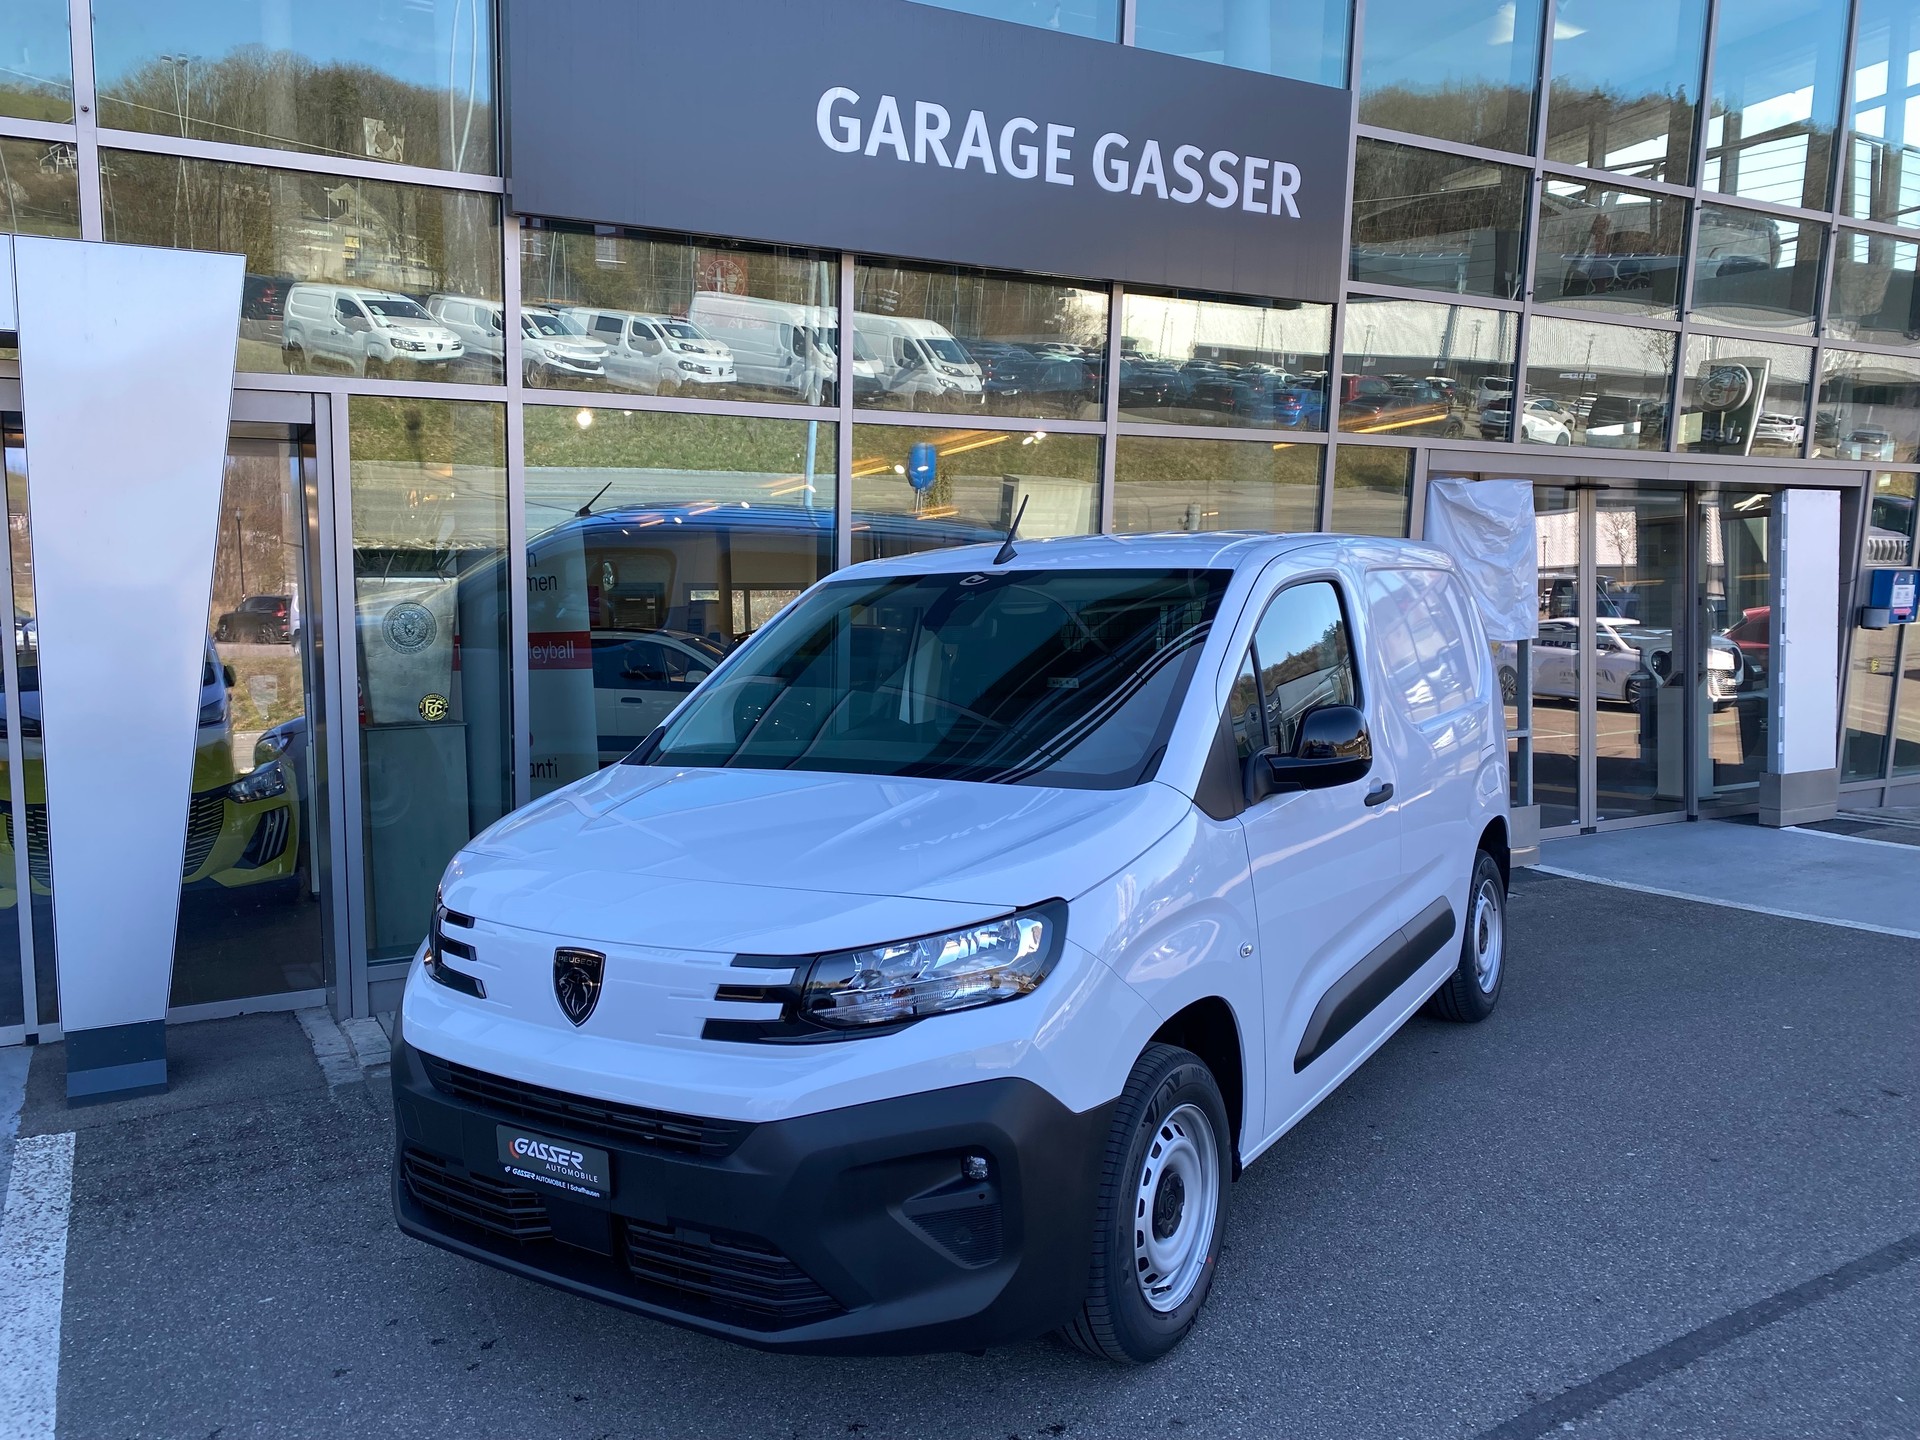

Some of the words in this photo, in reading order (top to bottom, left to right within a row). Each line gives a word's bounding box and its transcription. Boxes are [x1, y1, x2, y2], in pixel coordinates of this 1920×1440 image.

[816, 86, 1075, 186] GARAGE
[1092, 132, 1302, 218] GASSER
[558, 955, 599, 967] PEUGEOT
[514, 1137, 584, 1170] GASSER
[512, 1168, 536, 1180] GASSER
[535, 1174, 567, 1189] AUTOMOBILE
[545, 1163, 599, 1183] AUTOMOBILE
